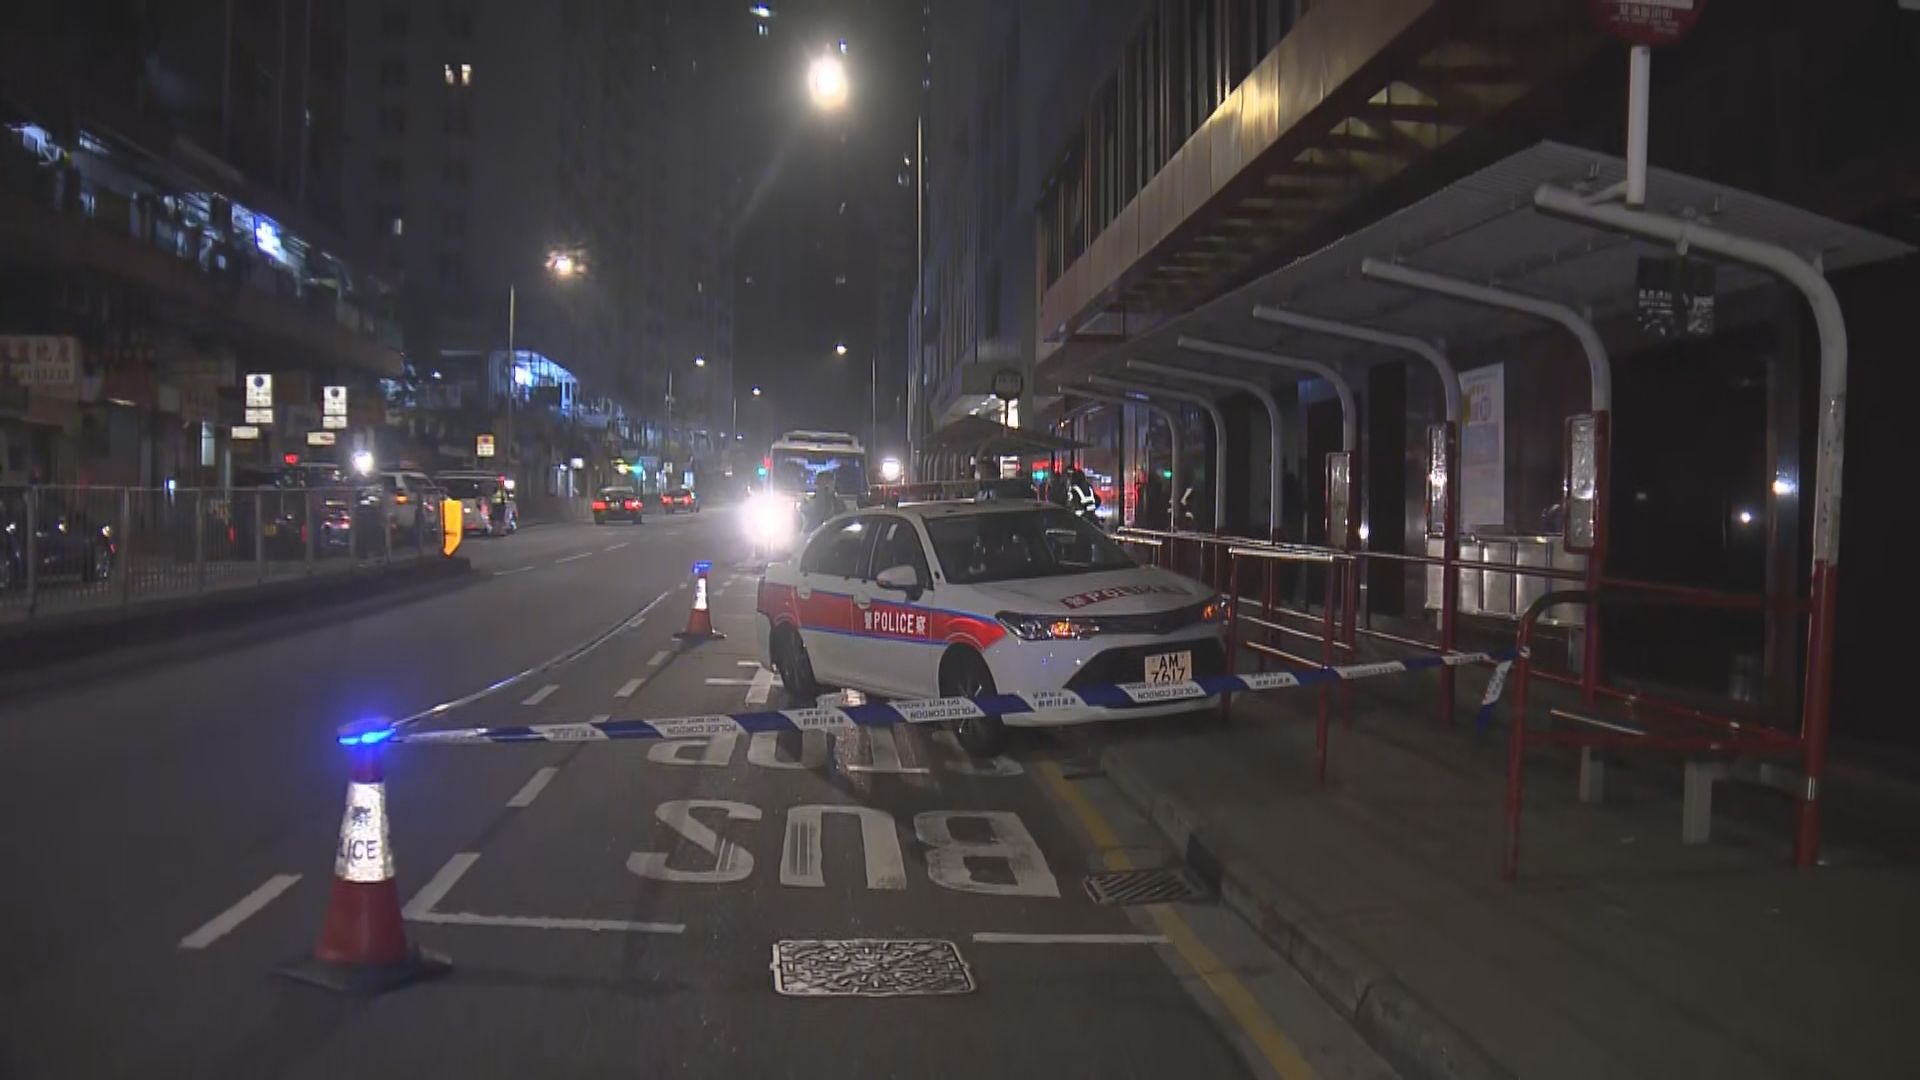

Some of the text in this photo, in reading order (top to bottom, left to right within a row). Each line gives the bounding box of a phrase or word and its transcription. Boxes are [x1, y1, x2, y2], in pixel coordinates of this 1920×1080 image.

[1159, 653, 1179, 670] AM
[1151, 668, 1186, 687] 7617
[626, 799, 1060, 898] BUS
